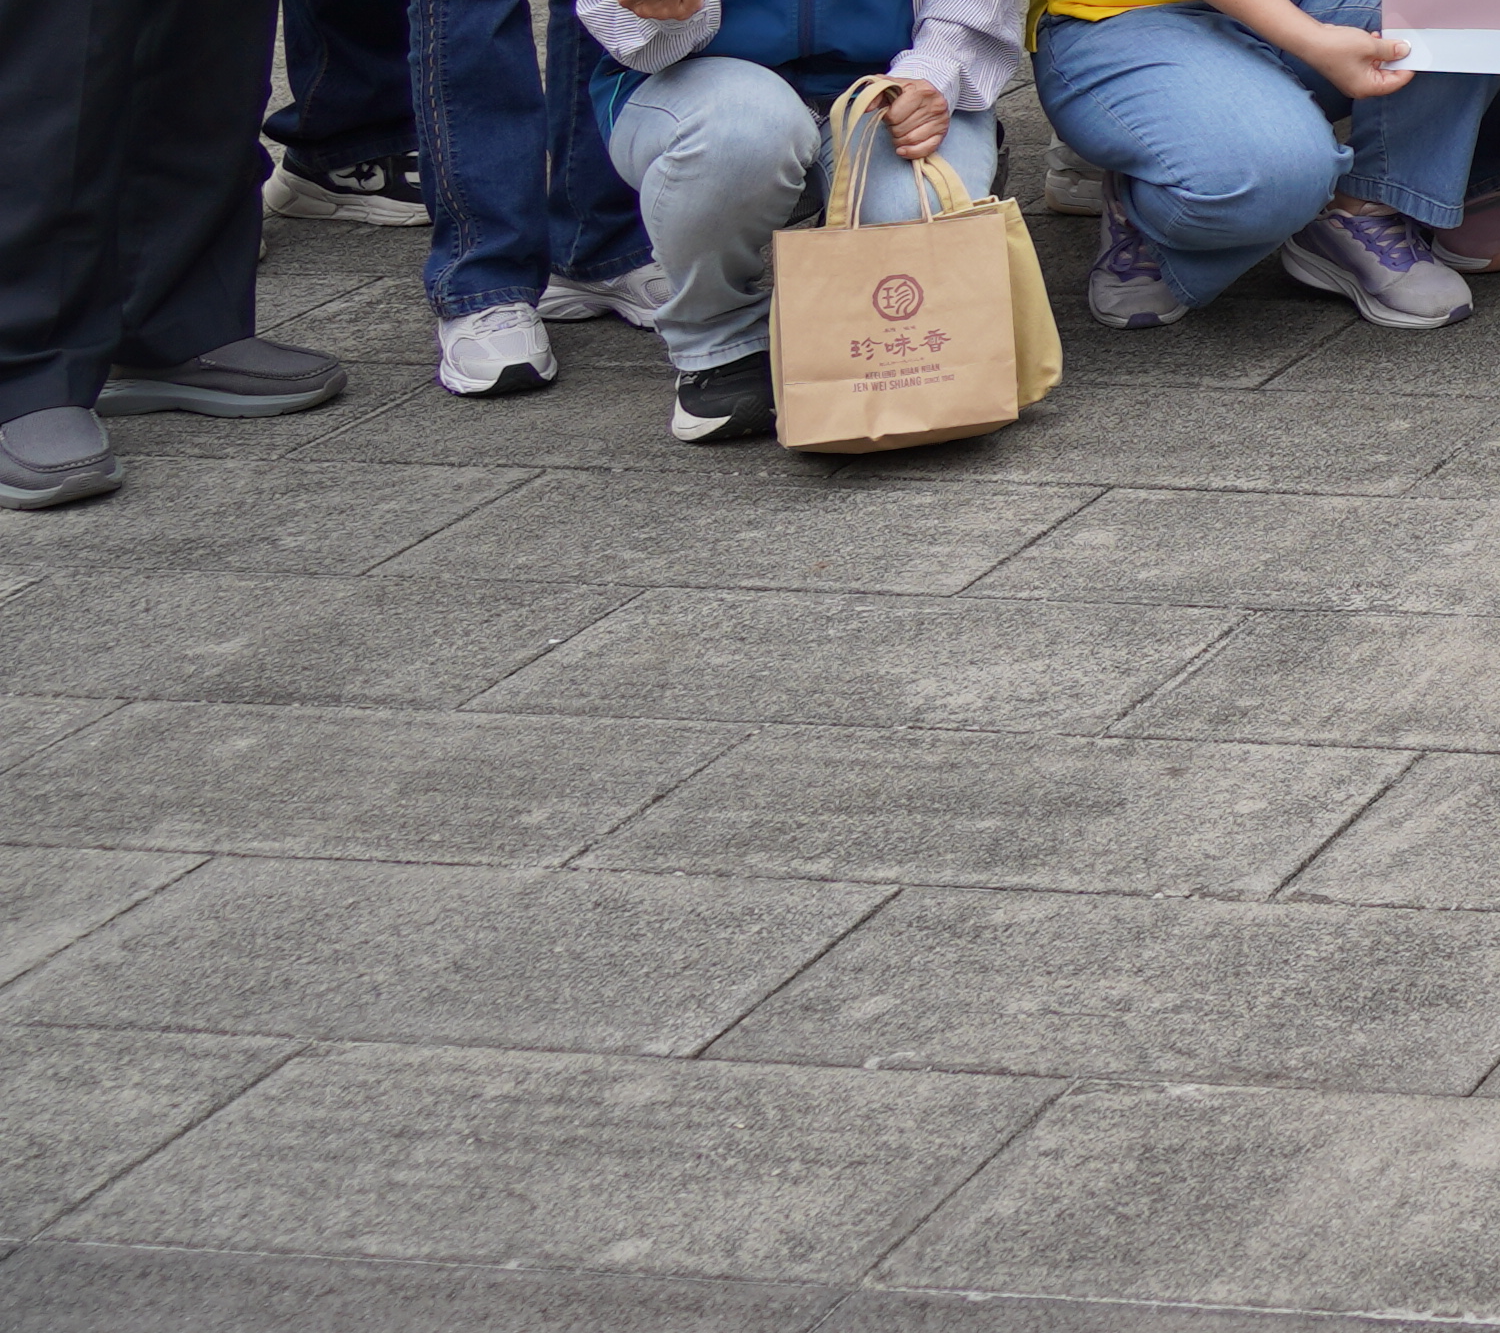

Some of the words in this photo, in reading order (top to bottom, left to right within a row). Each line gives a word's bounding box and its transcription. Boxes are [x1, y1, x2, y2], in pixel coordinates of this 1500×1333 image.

[850, 328, 952, 361] 珍味香
[870, 381, 887, 392] WEI
